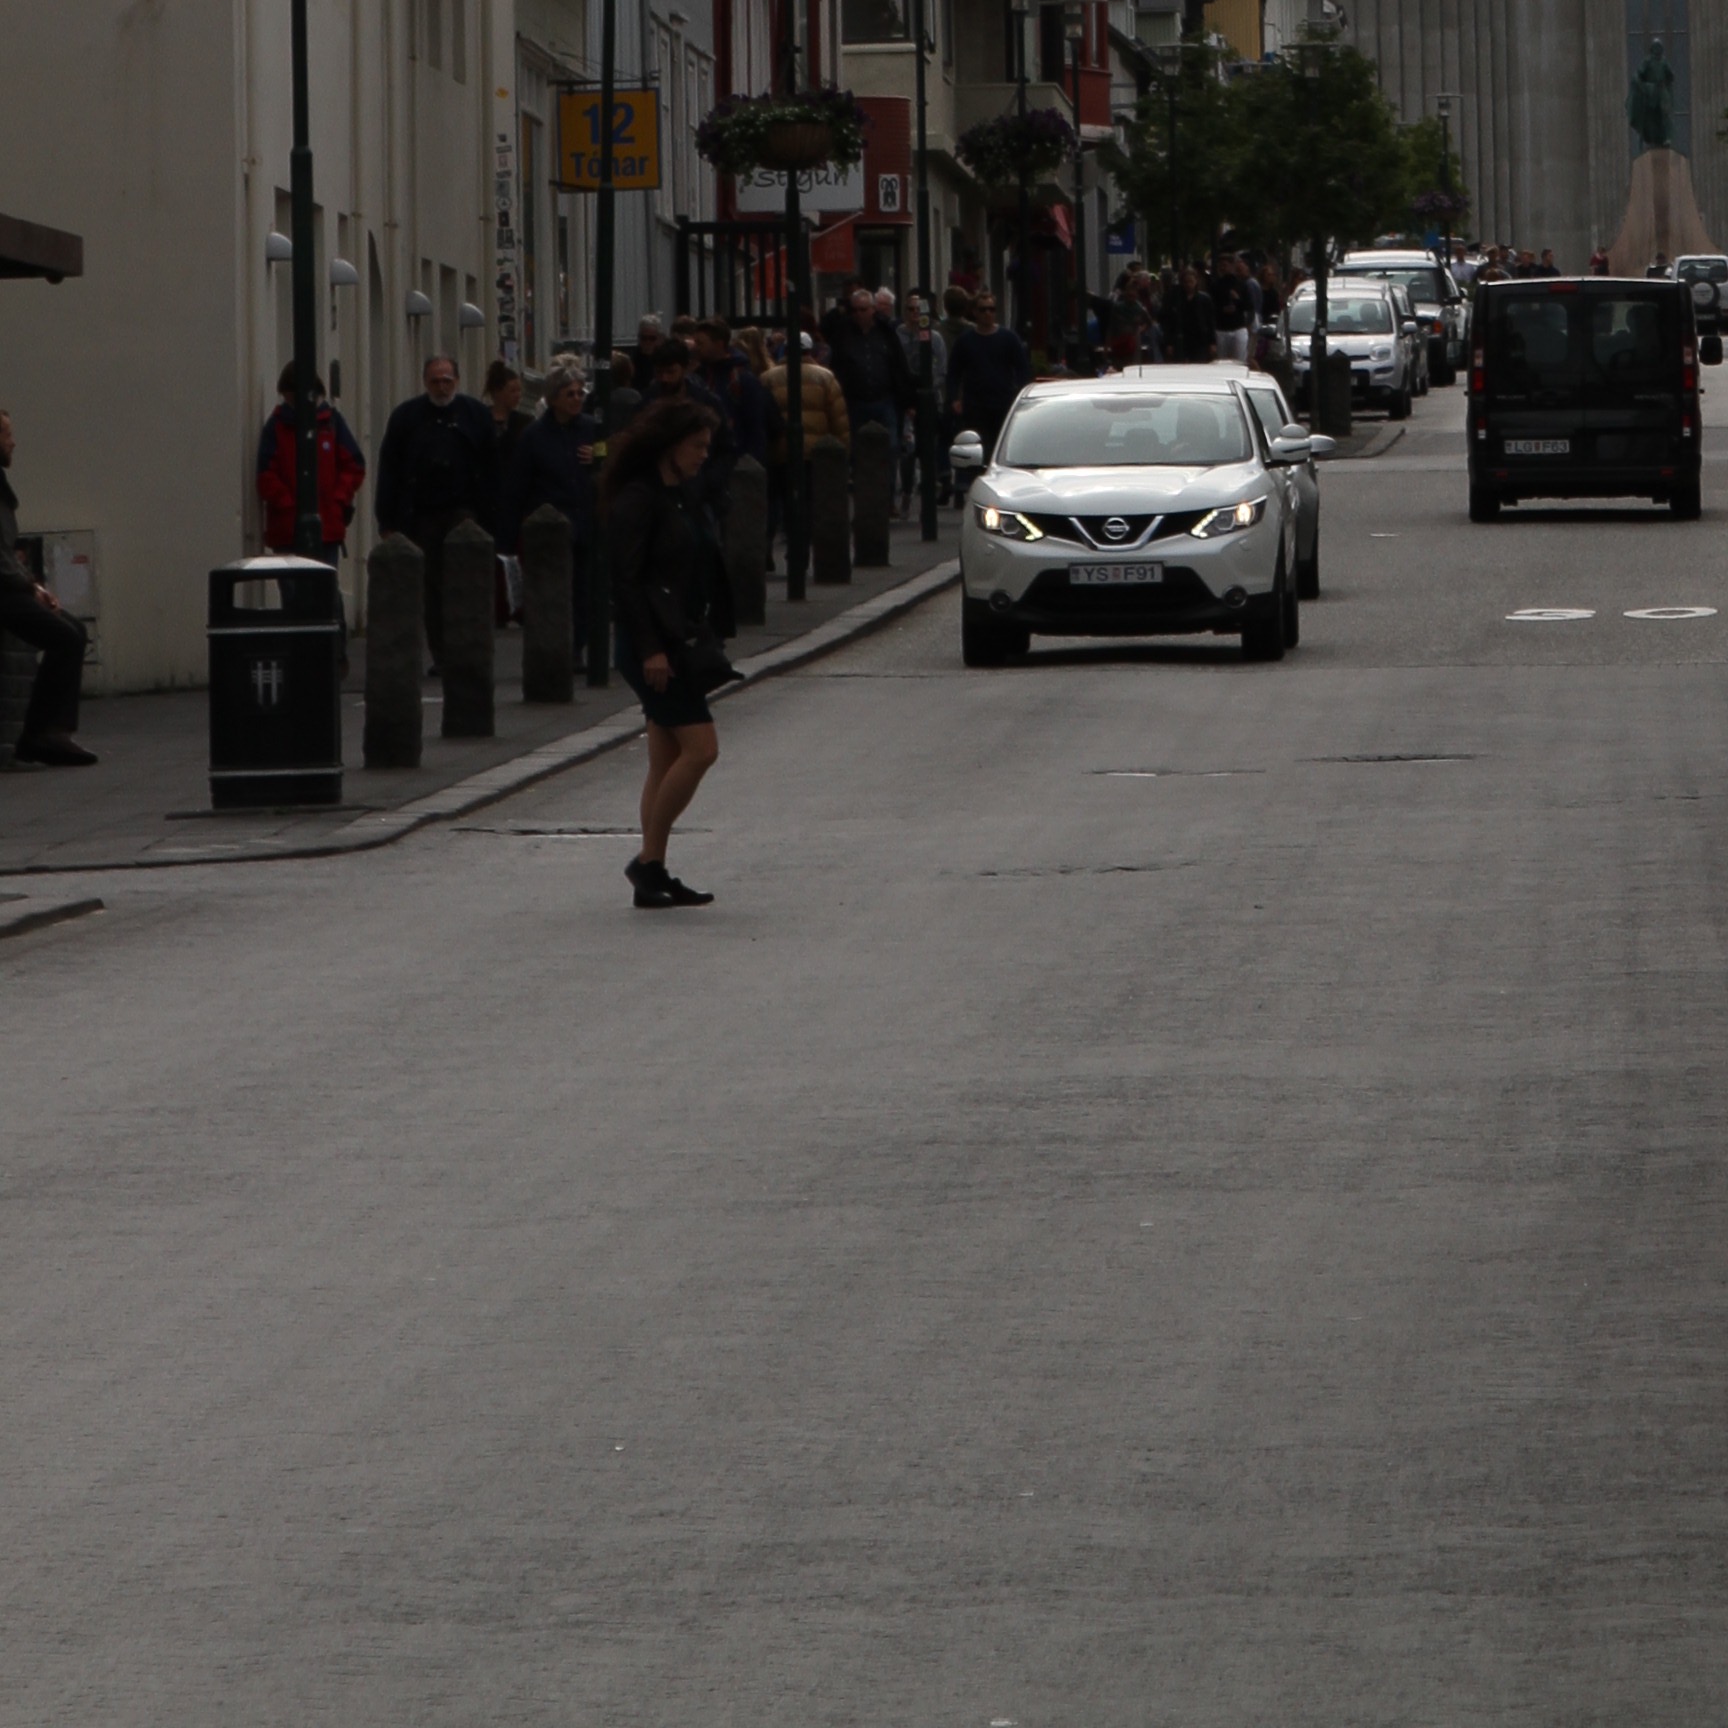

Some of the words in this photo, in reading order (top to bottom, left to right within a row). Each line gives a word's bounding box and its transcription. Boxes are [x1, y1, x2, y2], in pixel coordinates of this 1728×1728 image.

[582, 102, 636, 145] 12
[1083, 566, 1109, 582] YS
[1123, 565, 1156, 581] F91
